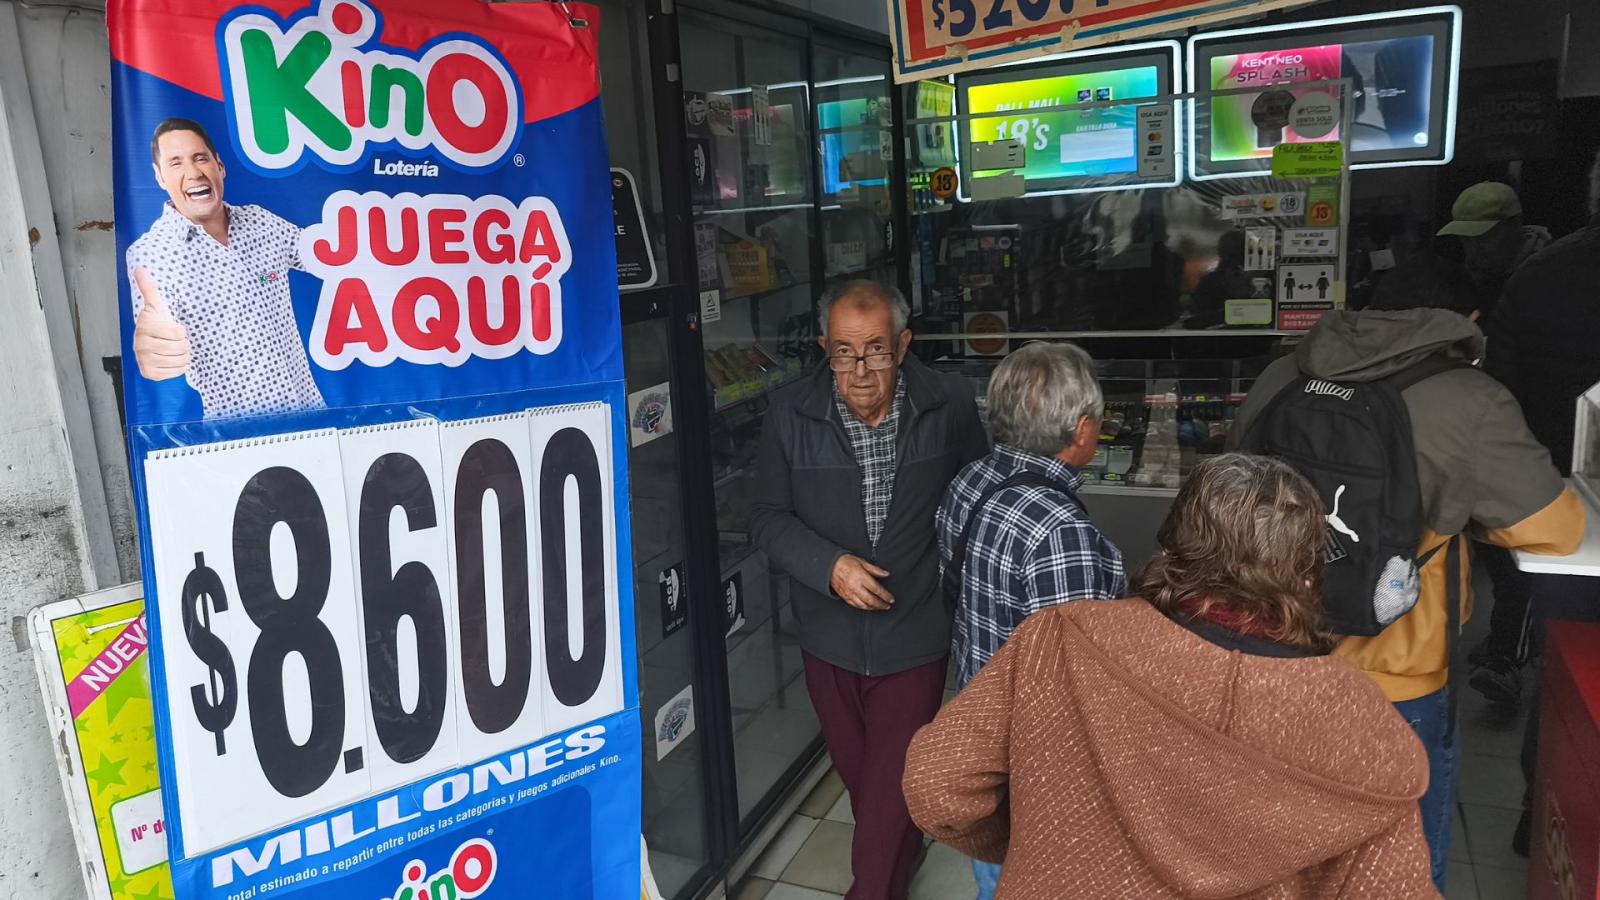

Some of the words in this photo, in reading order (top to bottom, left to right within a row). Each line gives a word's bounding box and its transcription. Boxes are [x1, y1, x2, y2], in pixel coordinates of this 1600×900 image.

[1236, 67, 1308, 83] SPLASH
[1241, 56, 1274, 69] KENT
[1276, 54, 1303, 65] NEO
[373, 158, 439, 177] Lotería
[313, 205, 561, 267] JUEGA
[324, 262, 551, 355] AQUÍ
[181, 427, 606, 798] $8.600
[211, 725, 606, 888] MILLONES
[260, 866, 319, 893] estimado
[321, 865, 329, 875] a
[333, 848, 374, 874] repartir
[376, 837, 404, 854] entre
[407, 824, 436, 842] todas
[438, 816, 453, 830] las
[508, 794, 515, 804] y
[516, 782, 548, 801] juegos
[551, 762, 596, 788] adicionales
[599, 754, 622, 768] Kino.
[398, 844, 492, 900] inO
